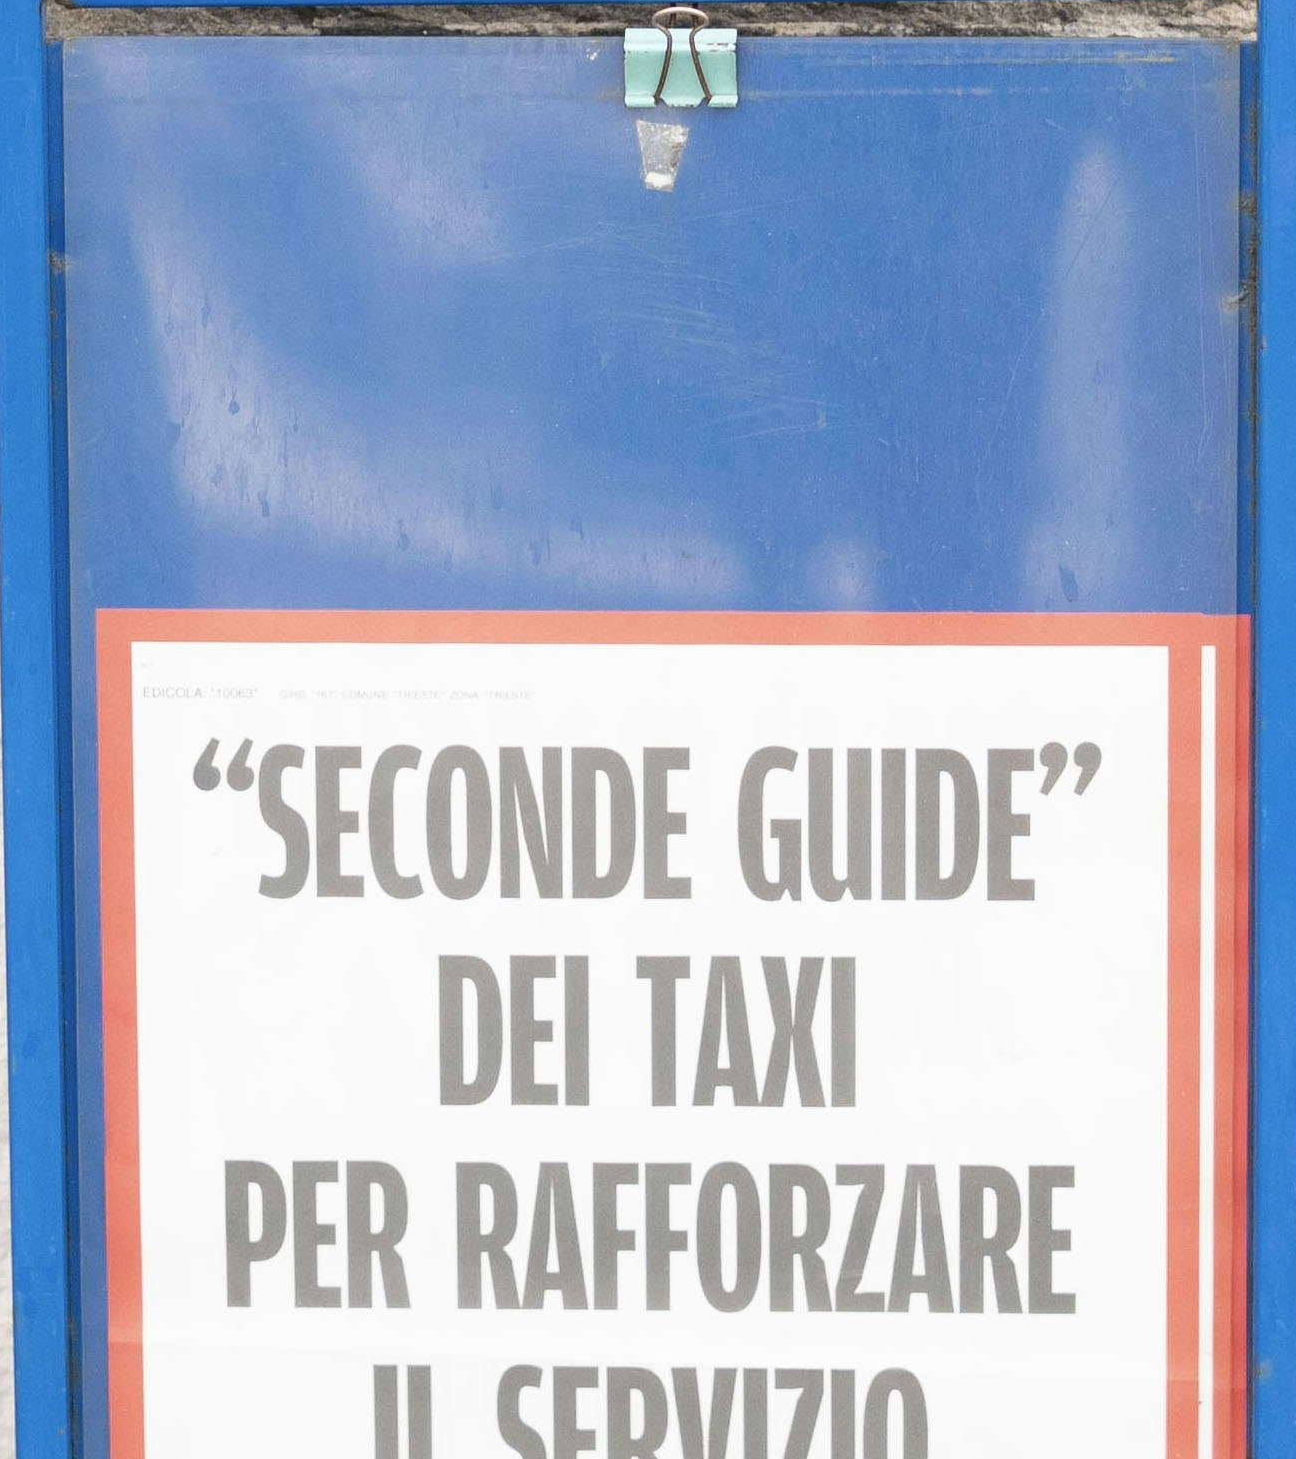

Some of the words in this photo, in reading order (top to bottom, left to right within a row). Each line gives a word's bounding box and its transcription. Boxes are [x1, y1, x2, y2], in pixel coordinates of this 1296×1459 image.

[438, 954, 589, 1107] DEI
[636, 956, 857, 1108] TAXI
[223, 1159, 410, 1310] PER
[455, 1162, 1076, 1314] RAFFORZARE
